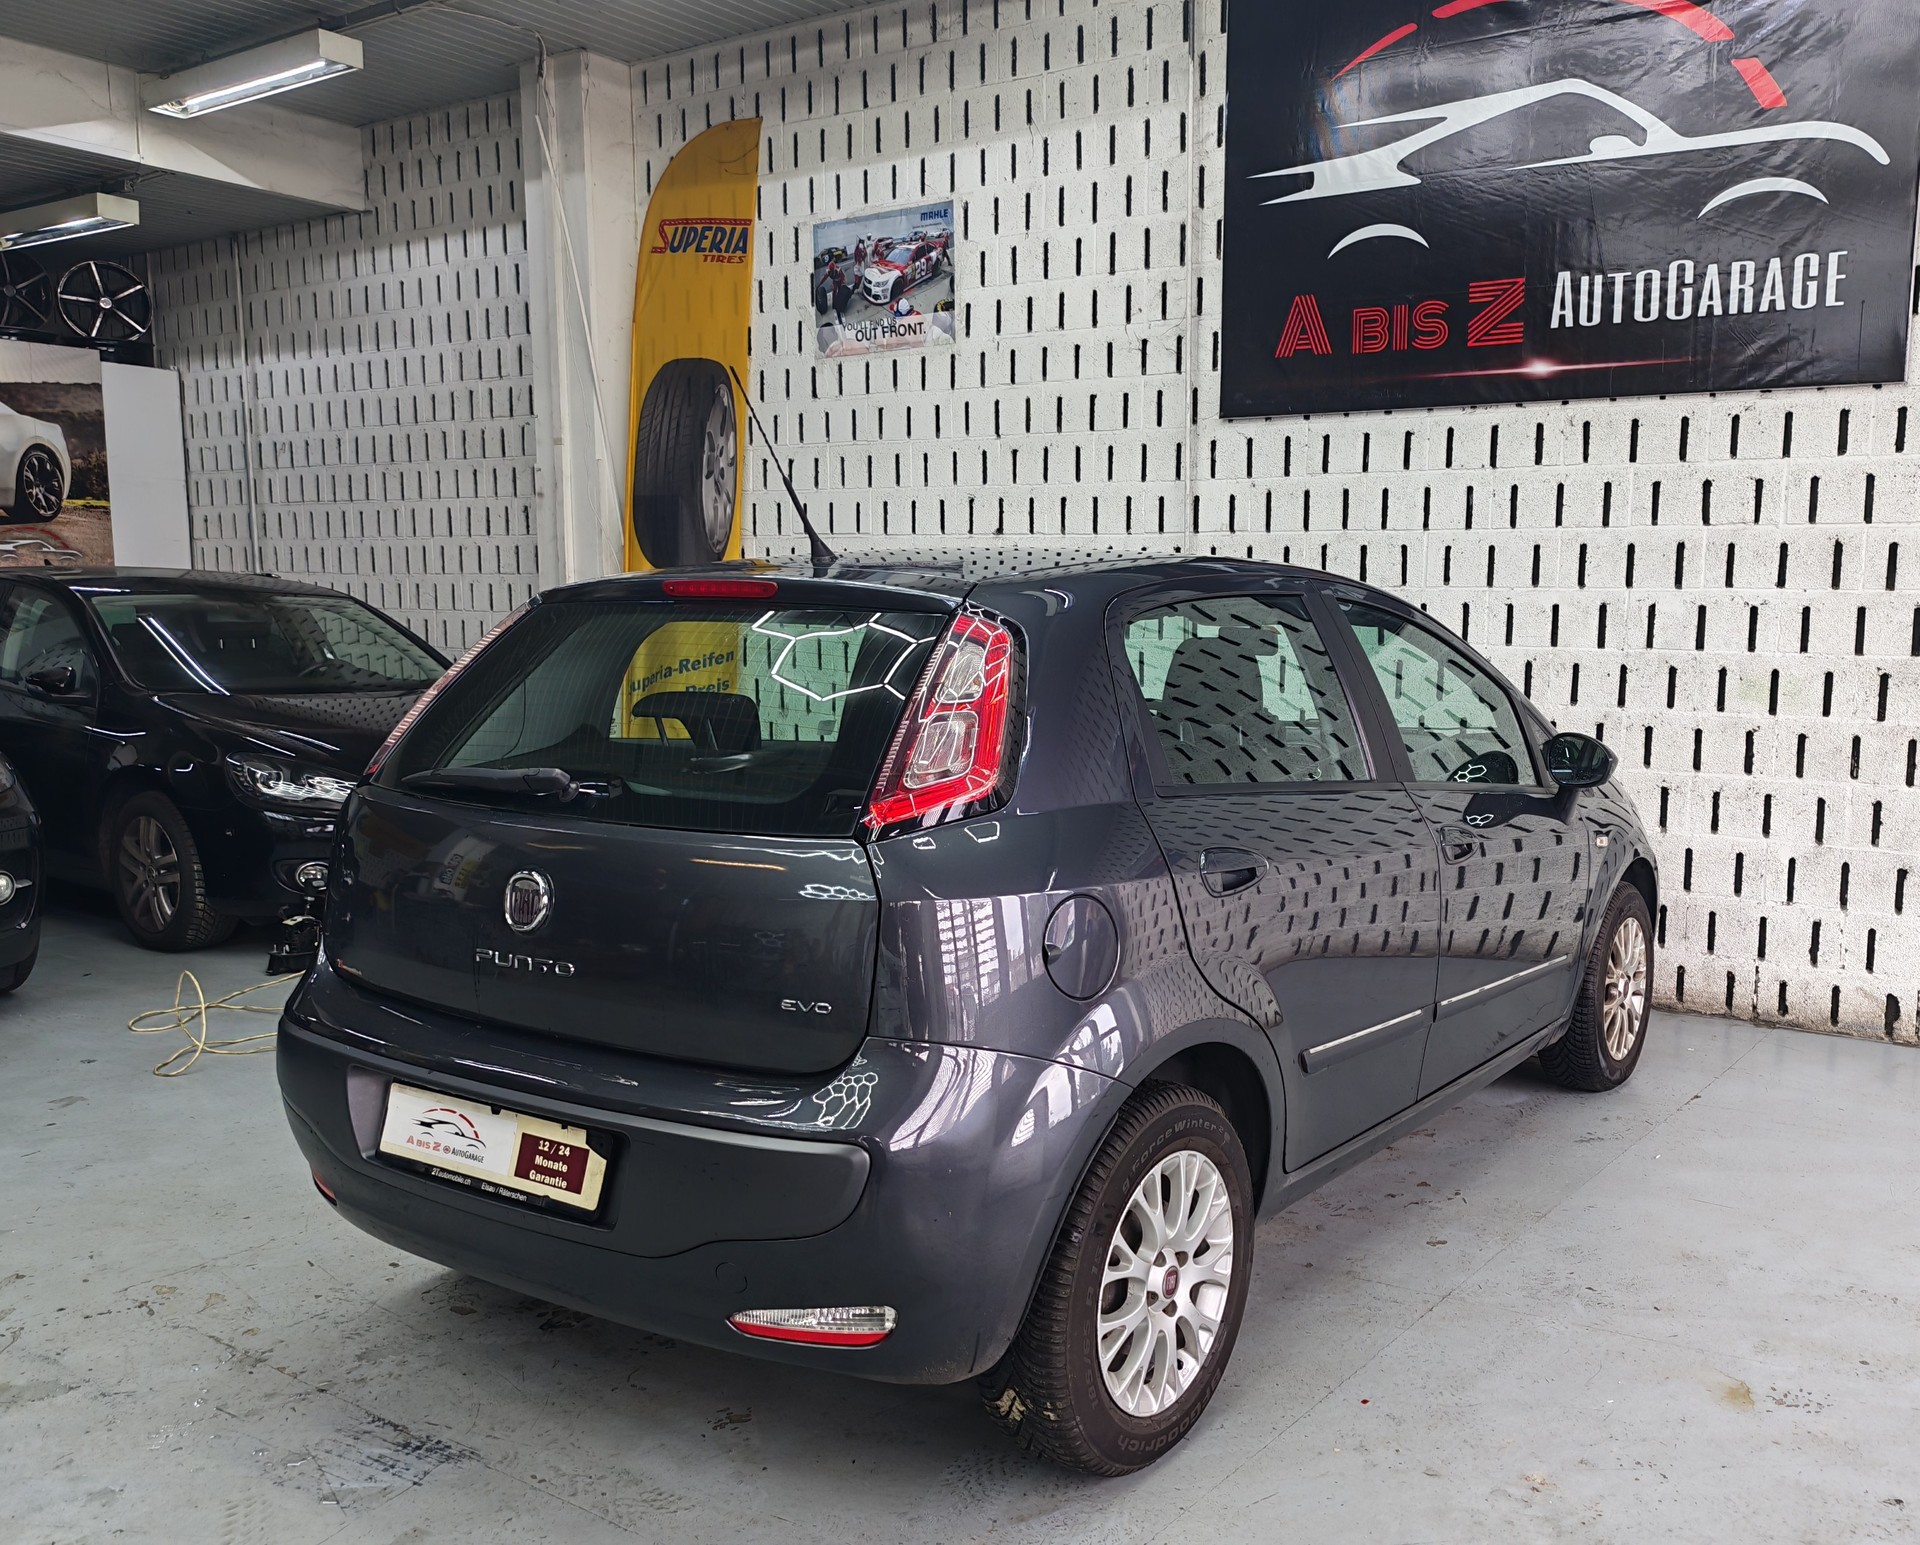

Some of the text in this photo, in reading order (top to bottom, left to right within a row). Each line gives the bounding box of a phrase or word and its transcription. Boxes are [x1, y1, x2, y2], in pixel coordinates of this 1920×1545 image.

[920, 209, 949, 221] MAHLE
[651, 218, 752, 254] SUPERIA
[703, 255, 746, 264] TIRES
[916, 258, 927, 279] 29
[886, 316, 898, 326] US
[1275, 294, 1332, 358] A
[1352, 299, 1449, 354] BIS
[1467, 277, 1525, 347] Z
[855, 322, 926, 342] OUT FRONT.
[629, 650, 734, 694] uperia-Reifen
[476, 948, 575, 977] PUNTO
[781, 999, 832, 1014] EVO
[406, 1135, 415, 1145] A
[432, 1141, 442, 1152] Z
[538, 1140, 571, 1157] 12 / 24
[534, 1155, 568, 1173] Monate
[529, 1169, 567, 1189] Garantie
